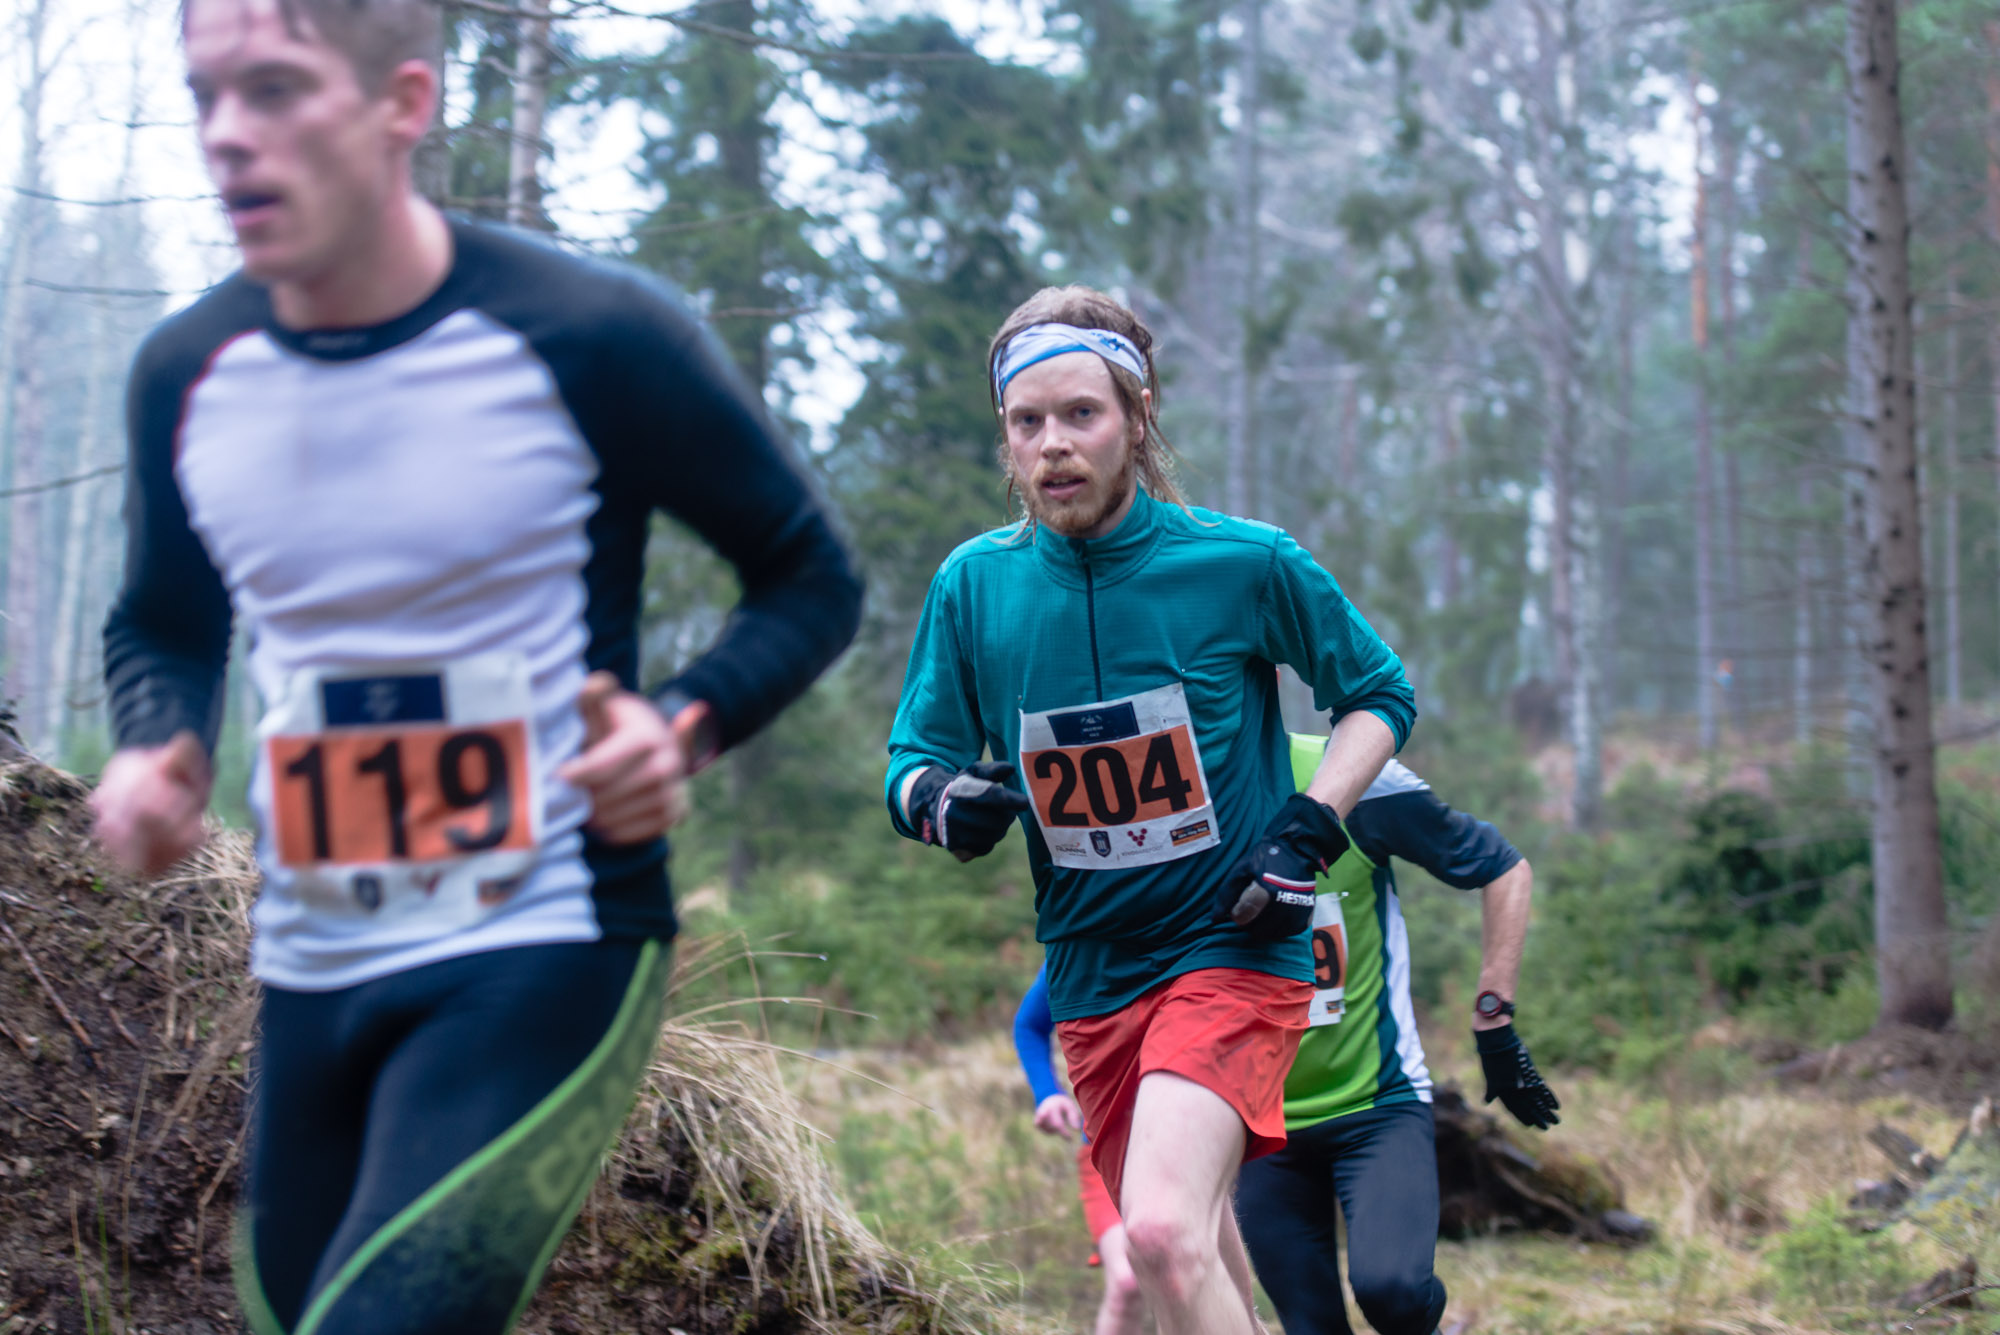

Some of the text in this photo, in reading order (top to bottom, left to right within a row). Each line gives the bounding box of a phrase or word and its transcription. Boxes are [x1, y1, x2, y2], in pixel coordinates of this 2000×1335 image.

[286, 732, 512, 861] 119
[1034, 734, 1192, 826] 204
[1276, 890, 1315, 906] HESTRA
